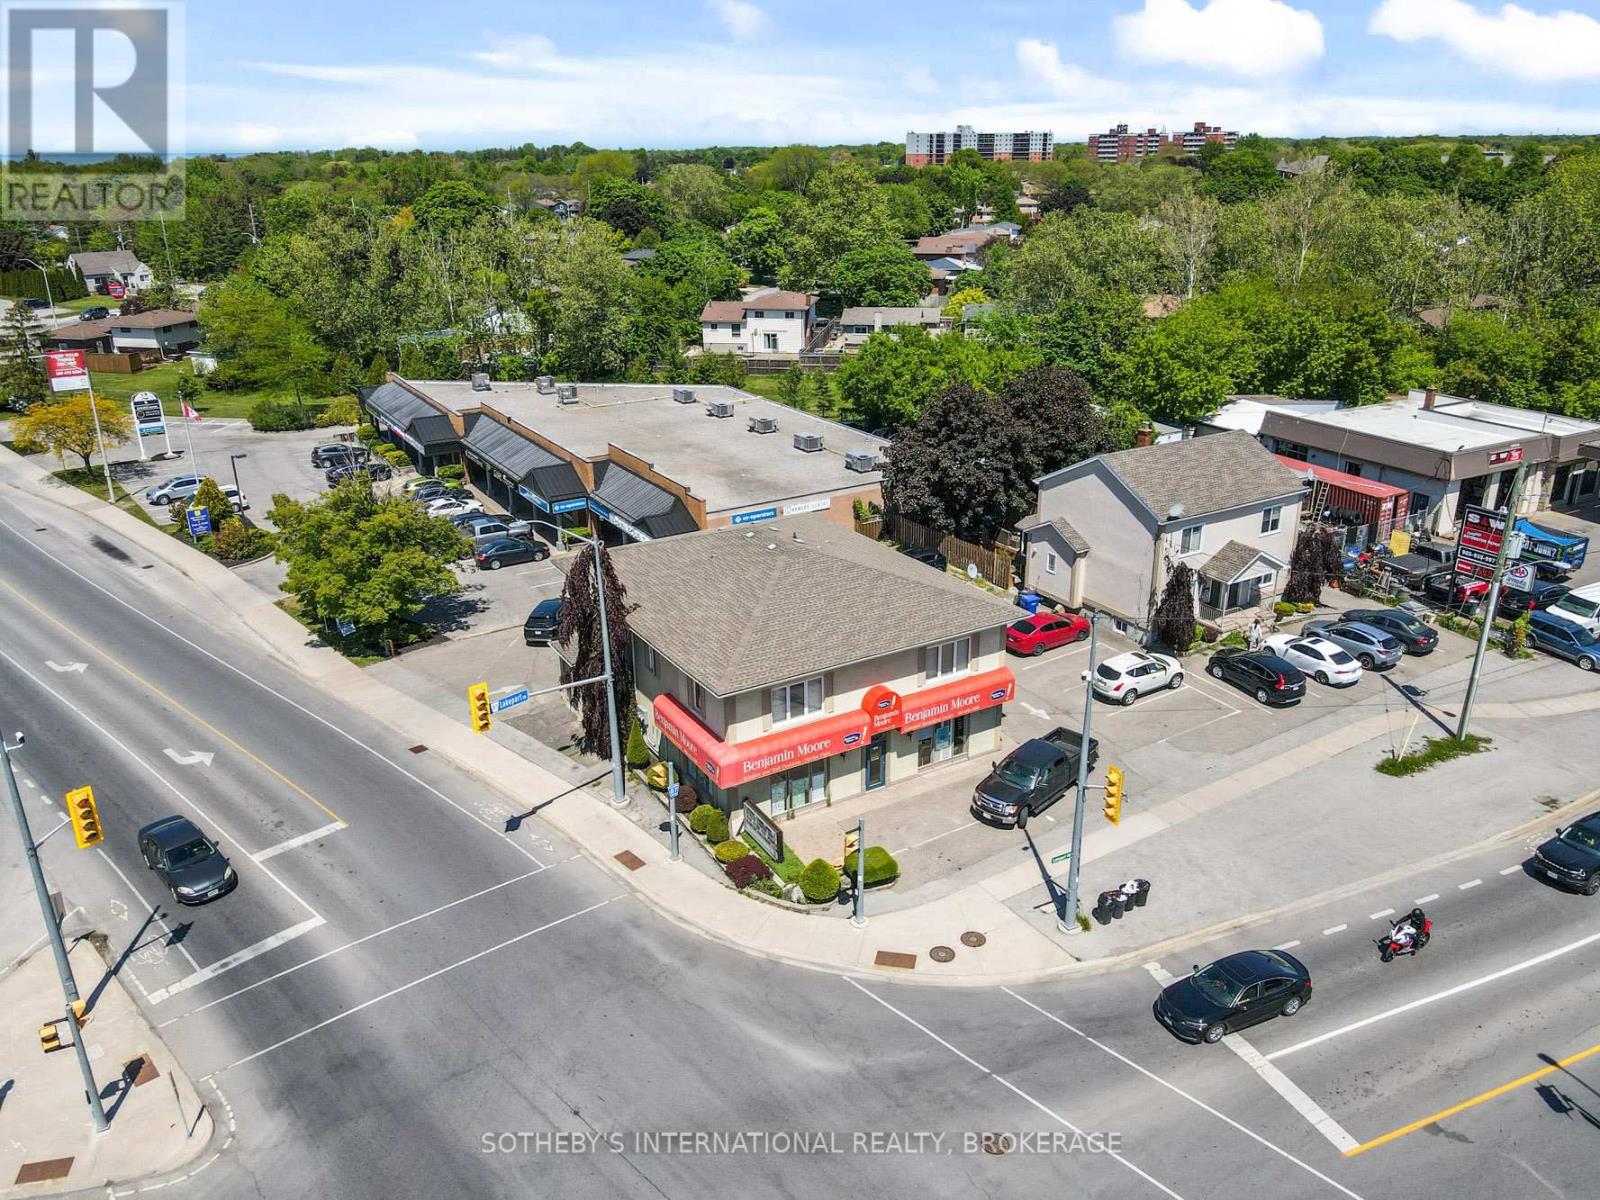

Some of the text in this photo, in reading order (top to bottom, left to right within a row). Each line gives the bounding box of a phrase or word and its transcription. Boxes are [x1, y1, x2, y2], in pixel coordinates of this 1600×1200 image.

[500, 694, 522, 709] Lakeport
[905, 703, 949, 723] Benjamin
[951, 693, 980, 710] Moore
[874, 710, 900, 721] Benjamin
[743, 749, 794, 773] Benjamin
[797, 739, 832, 757] Moore
